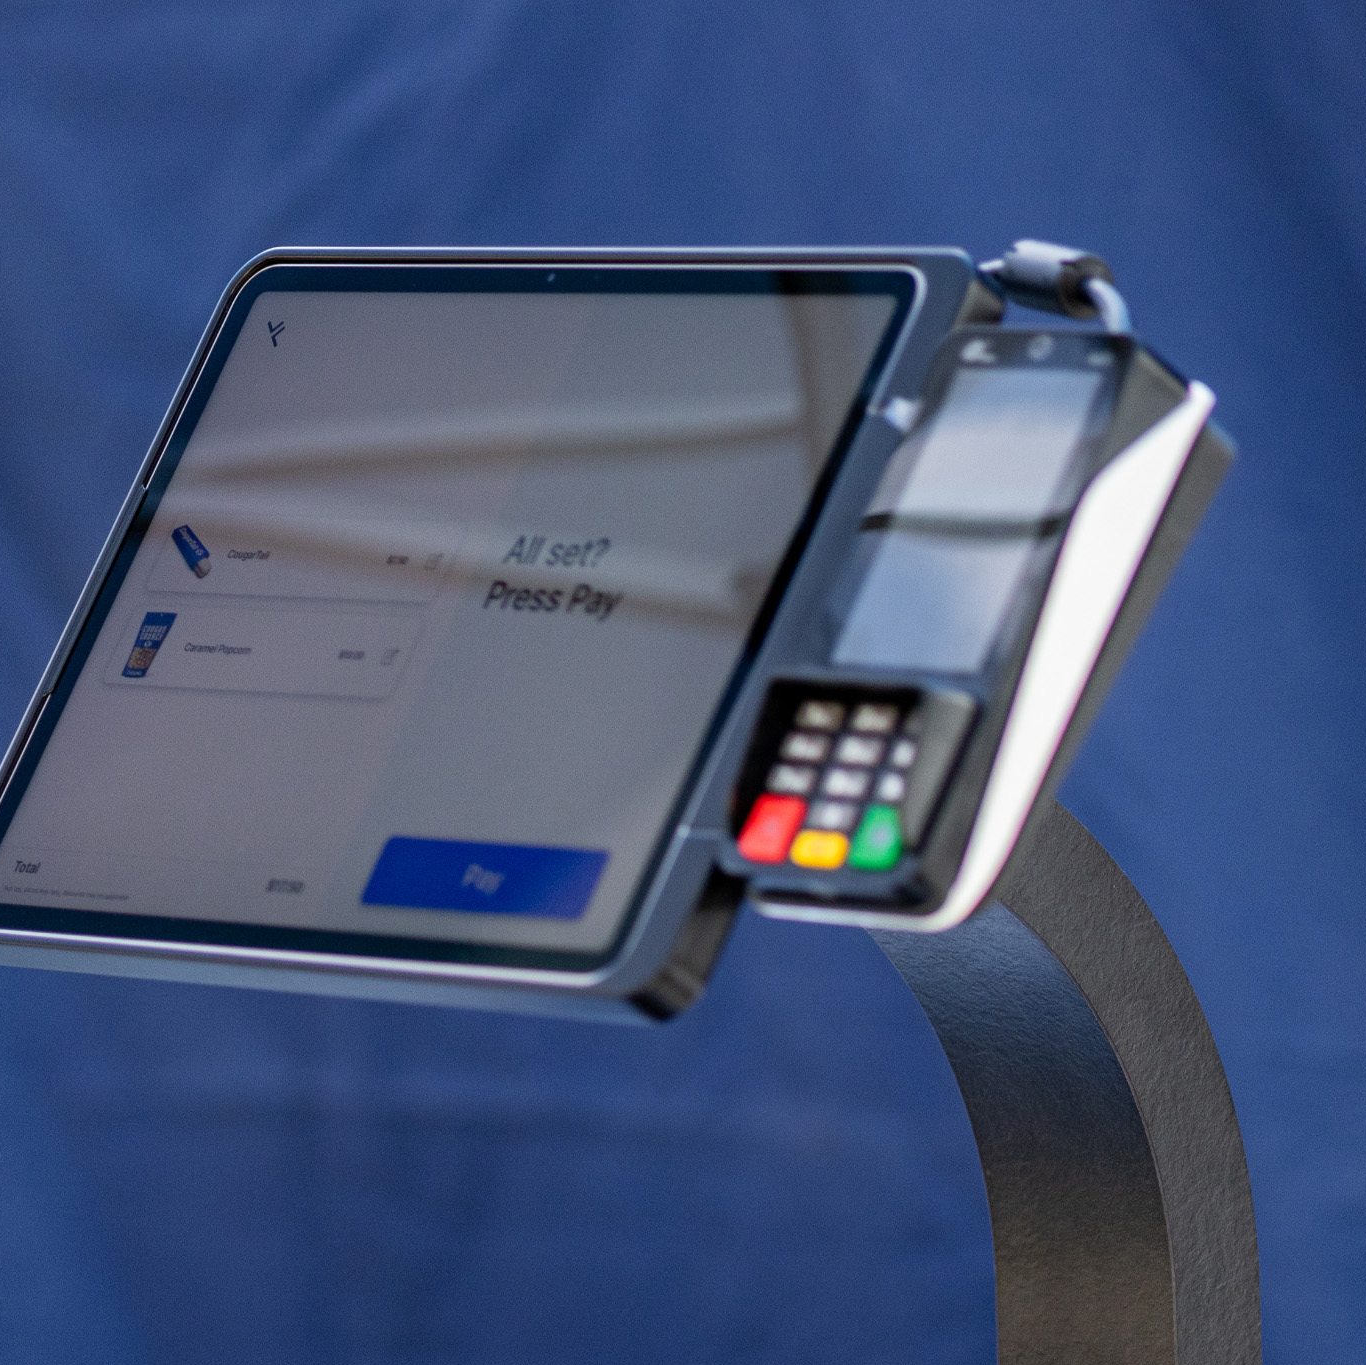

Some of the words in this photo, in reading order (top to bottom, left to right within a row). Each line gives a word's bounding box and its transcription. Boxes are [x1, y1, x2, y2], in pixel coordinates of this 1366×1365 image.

[227, 549, 271, 562] CougarTail
[502, 534, 546, 565] All
[546, 536, 612, 568] set?
[483, 579, 564, 613] Press
[565, 583, 625, 623] Pay
[184, 642, 219, 654] Caramel
[15, 860, 42, 874] Total
[462, 863, 506, 896] Pay
